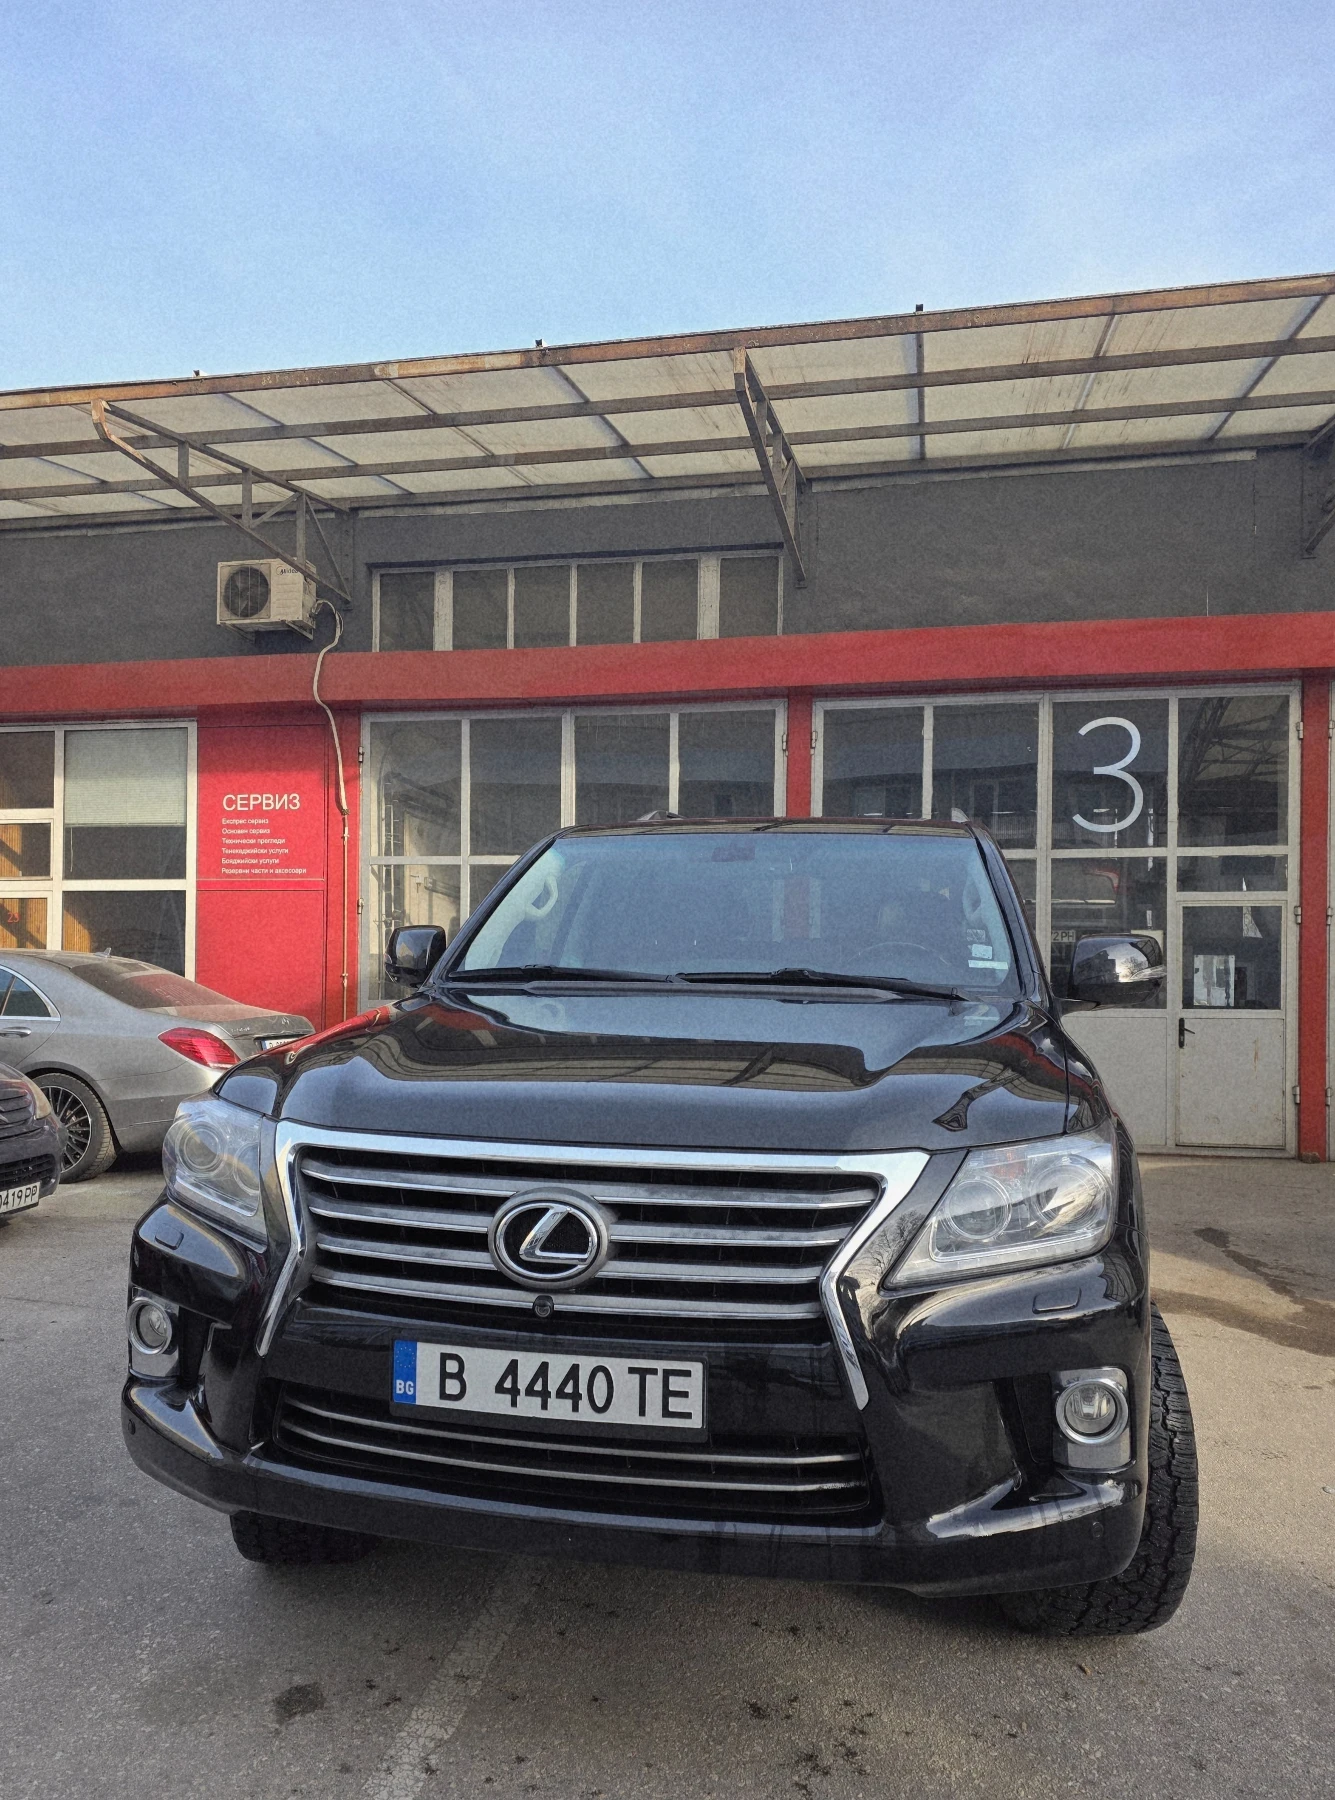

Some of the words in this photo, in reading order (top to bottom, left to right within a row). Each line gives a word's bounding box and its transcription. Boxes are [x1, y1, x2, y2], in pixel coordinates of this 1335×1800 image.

[1072, 716, 1144, 833] 3
[222, 793, 301, 811] СЕРВИЗ
[275, 867, 307, 875] аксесоари
[395, 1379, 414, 1395] BG
[439, 1352, 467, 1401] B
[494, 1358, 614, 1414] 4440
[627, 1366, 692, 1419] TE
